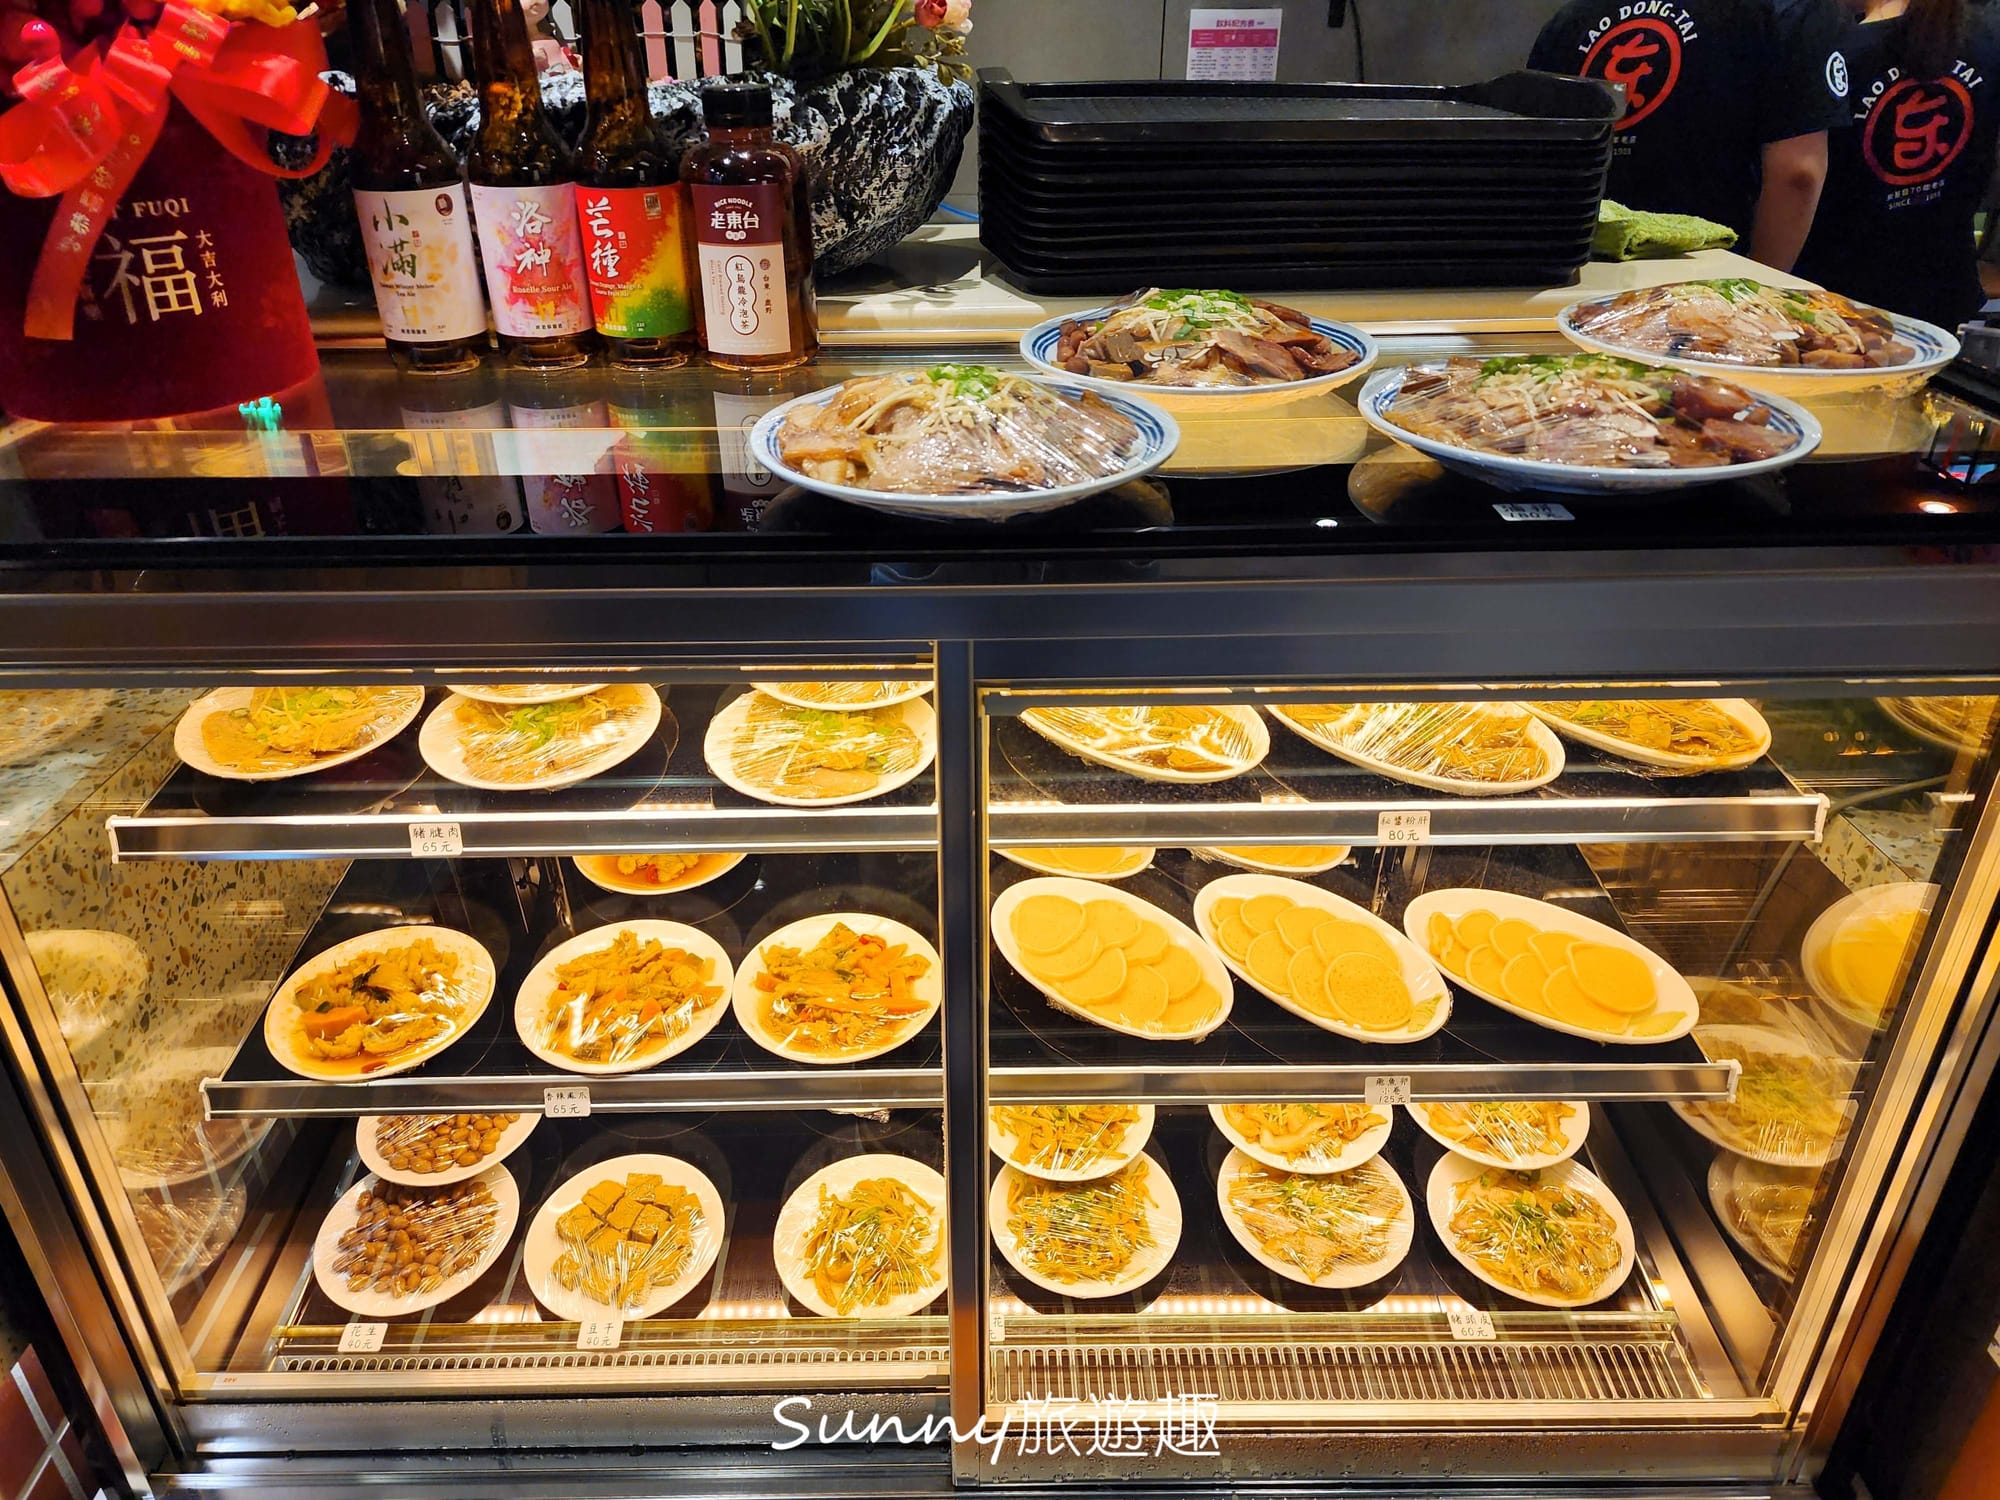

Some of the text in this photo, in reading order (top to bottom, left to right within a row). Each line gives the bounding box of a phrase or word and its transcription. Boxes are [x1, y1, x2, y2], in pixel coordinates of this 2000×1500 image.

[1578, 0, 1698, 53] LAO DONG-TAI
[1854, 81, 1884, 120] LAO
[132, 197, 191, 218] FUQI
[713, 198, 728, 208] RICE
[728, 197, 753, 208] NOODLE
[711, 210, 760, 229] 老東台
[372, 198, 417, 279] 小滿
[511, 200, 552, 277] 洛神
[585, 195, 620, 278] 芒種
[195, 229, 229, 308] 大吉大利
[95, 229, 203, 325] 福
[541, 285, 560, 293] Sour
[561, 283, 573, 291] Ale
[734, 261, 751, 330] 紅烏龍冷泡茶
[1388, 829, 1420, 841] 80元
[422, 840, 453, 853] 65元
[1379, 1094, 1407, 1104] 125元
[553, 1103, 581, 1114] 65元
[350, 1324, 377, 1337] 花生
[586, 1322, 614, 1335] 豆干
[1460, 1326, 1488, 1337] 60元
[347, 1338, 373, 1349] 40元
[586, 1336, 612, 1346] 40元
